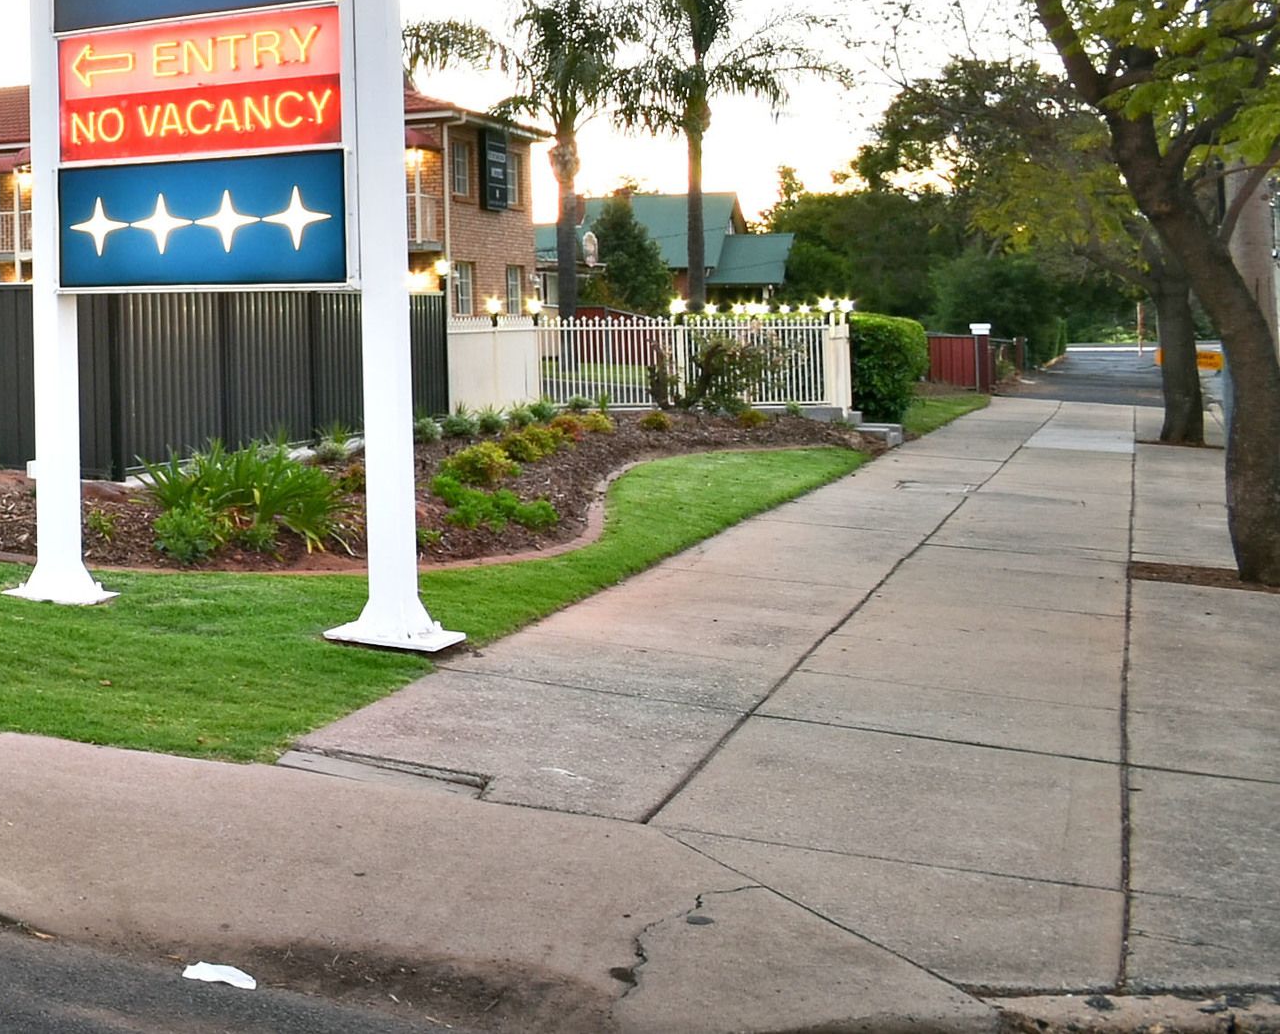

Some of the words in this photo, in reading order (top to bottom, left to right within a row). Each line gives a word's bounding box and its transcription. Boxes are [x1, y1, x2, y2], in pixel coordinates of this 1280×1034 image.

[152, 25, 321, 78] ENTRY
[71, 108, 125, 144] NO
[138, 89, 333, 137] VACANCY
